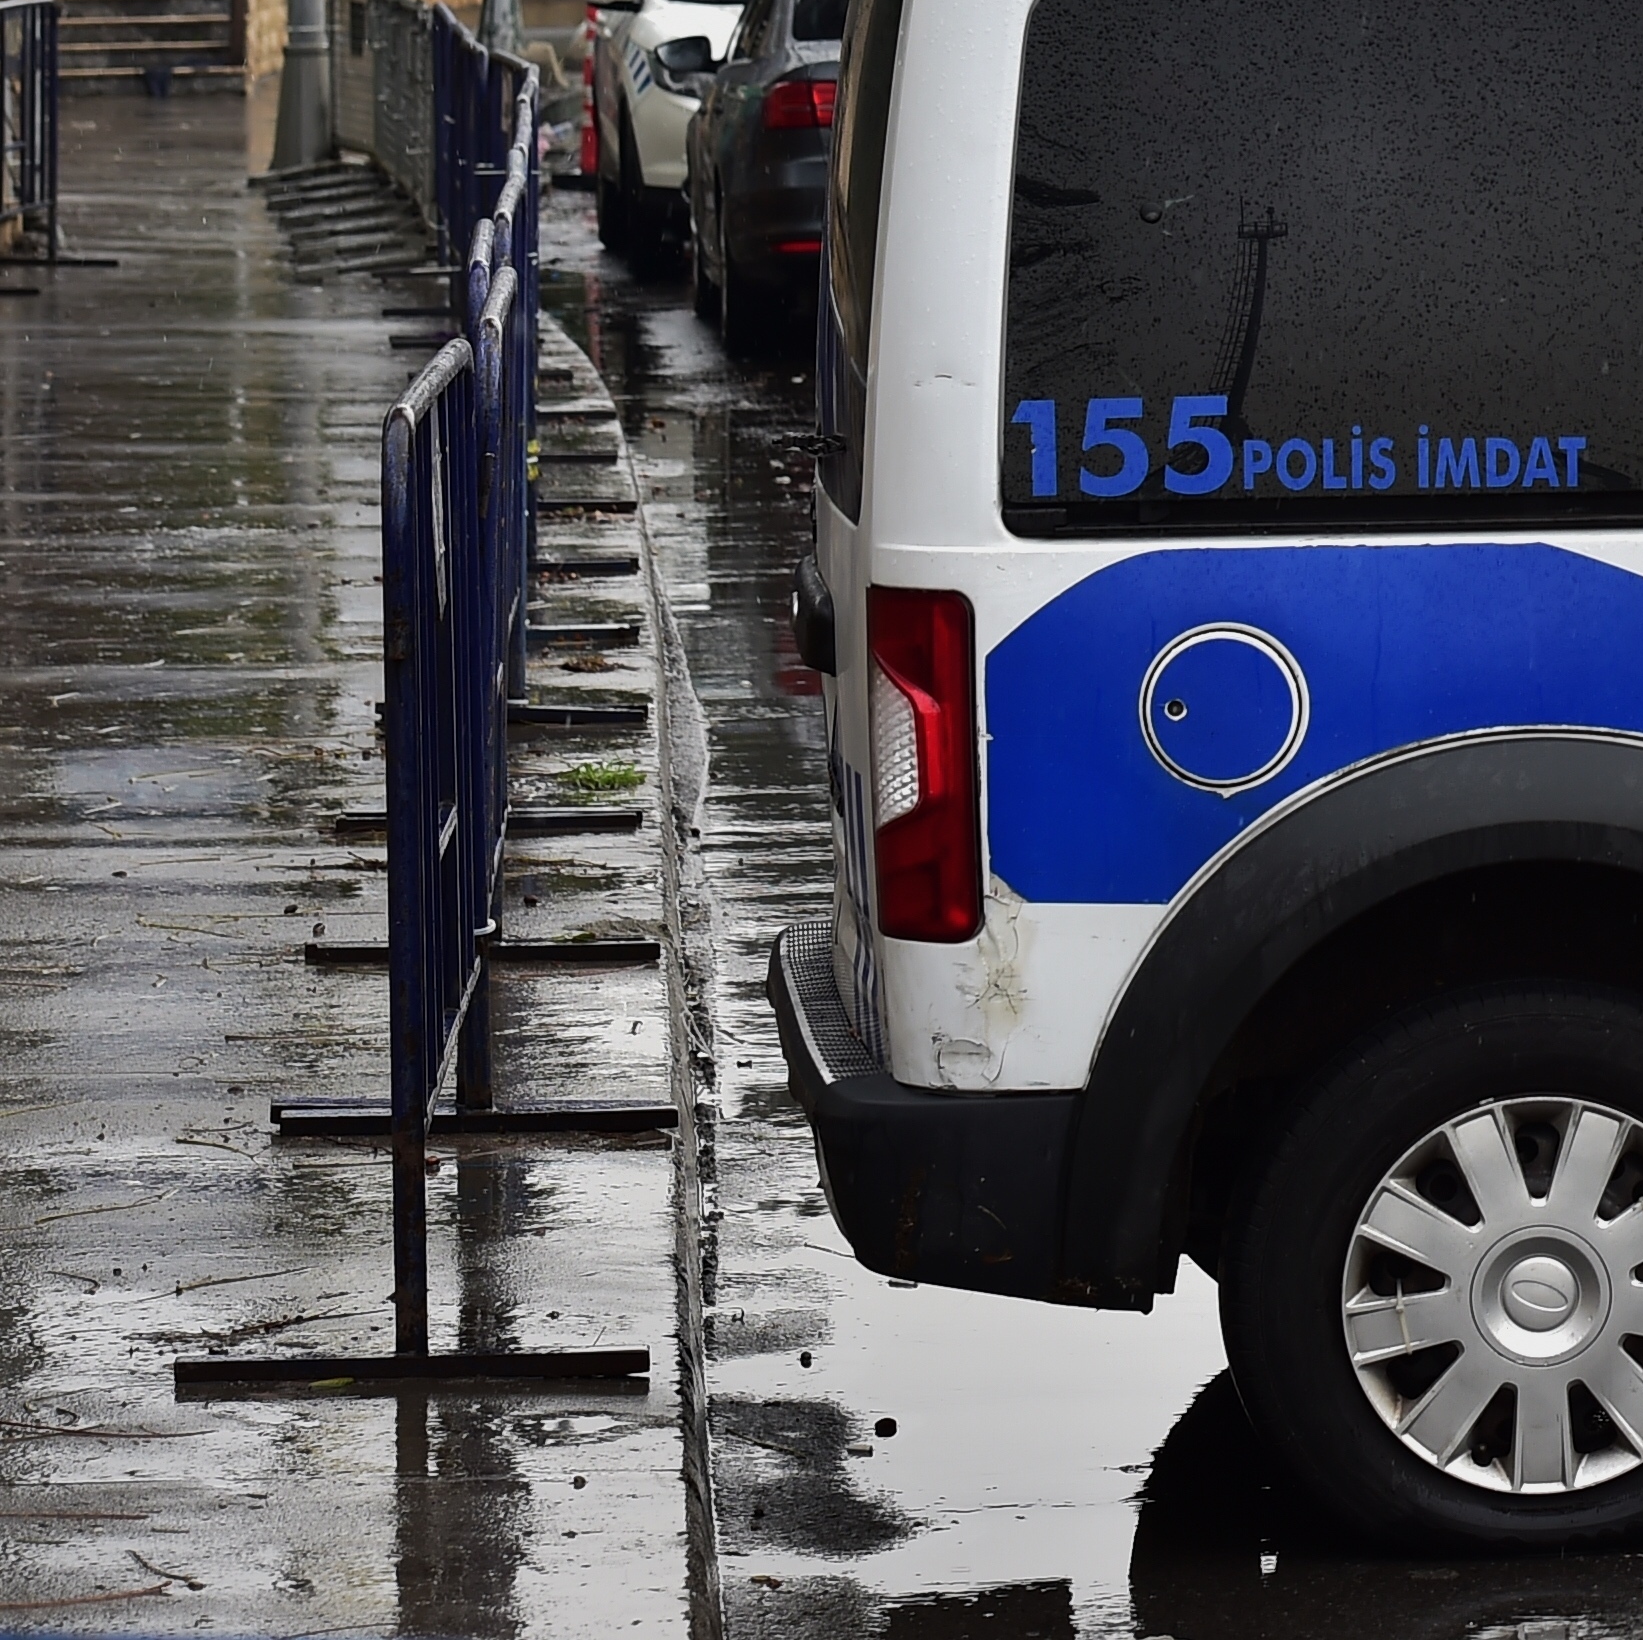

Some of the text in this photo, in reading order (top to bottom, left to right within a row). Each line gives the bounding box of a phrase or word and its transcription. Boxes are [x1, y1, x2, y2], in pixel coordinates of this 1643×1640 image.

[1011, 395, 1587, 498] 155 POLİS İMDAT
